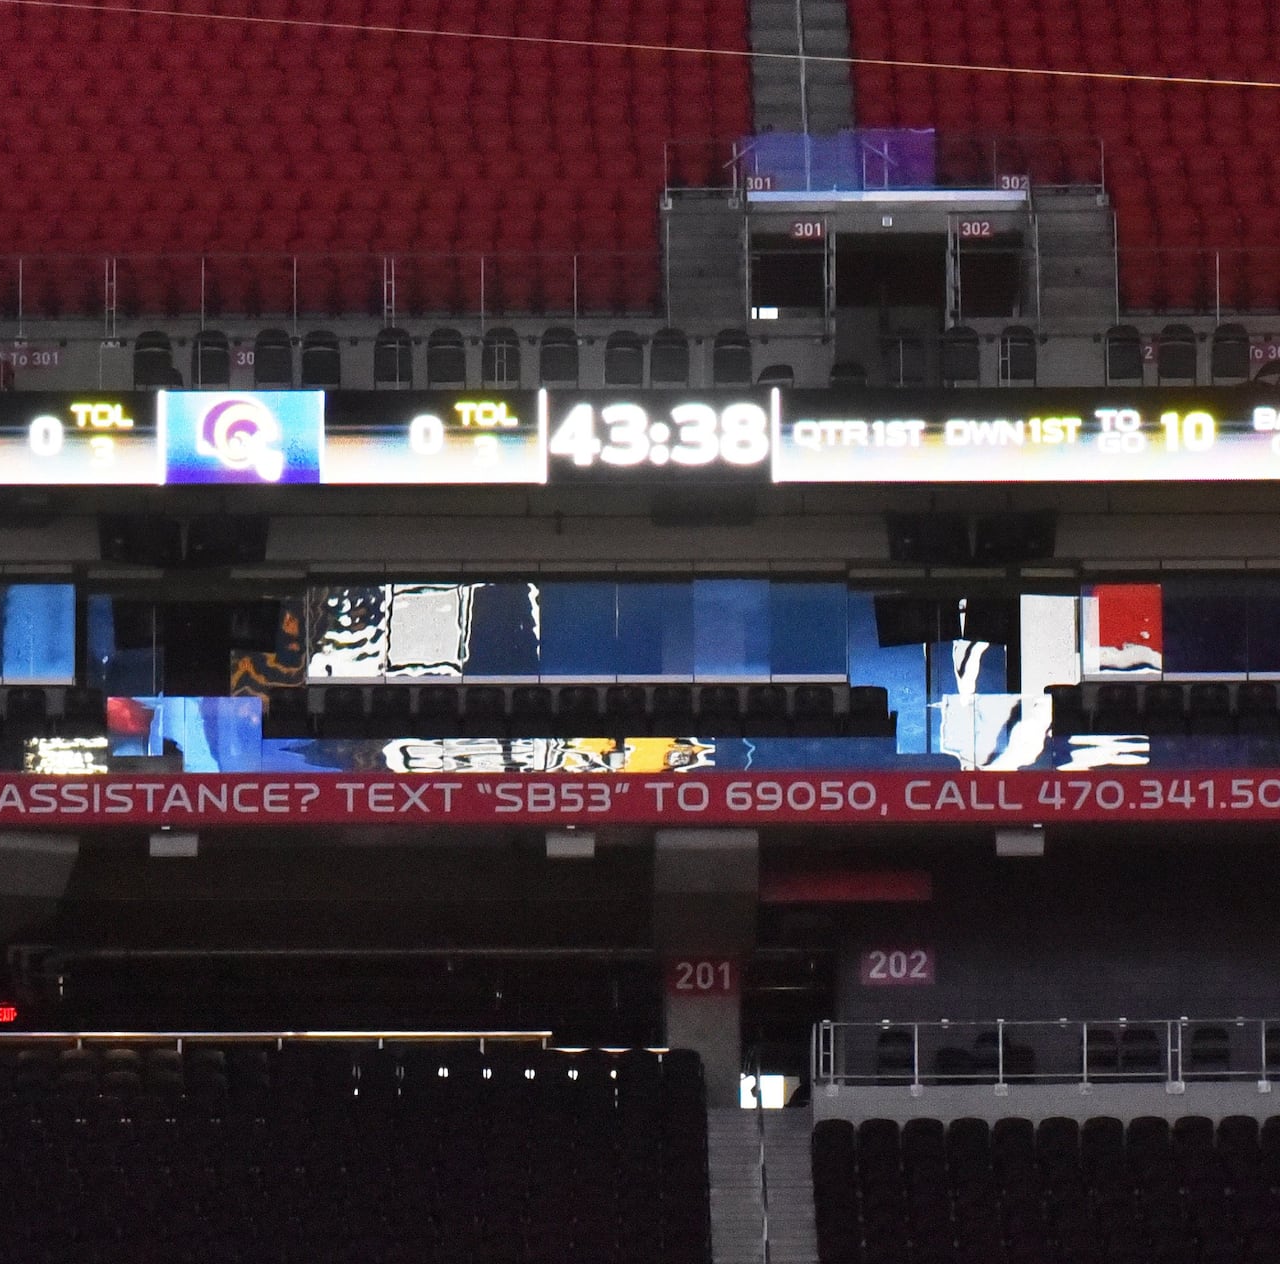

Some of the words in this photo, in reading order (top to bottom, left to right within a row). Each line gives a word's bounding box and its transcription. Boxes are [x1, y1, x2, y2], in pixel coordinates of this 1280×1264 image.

[746, 177, 771, 190] 301
[1001, 176, 1029, 189] 302
[794, 223, 821, 236] 301
[962, 222, 990, 236] 302
[10, 352, 27, 366] To
[32, 351, 59, 365] 301
[70, 404, 133, 428] TOL
[454, 402, 518, 427] TOL
[1095, 409, 1141, 433] TO
[550, 402, 769, 466] 43:38
[793, 420, 868, 451] QTR
[871, 420, 926, 447] 1ST
[1029, 417, 1082, 444] 1ST
[1096, 431, 1146, 454] GO
[1160, 411, 1216, 453] 10
[335, 782, 463, 813] TEXT
[644, 781, 709, 812] TO
[726, 780, 888, 817] 69050,
[905, 780, 1023, 811] CALL
[675, 961, 731, 989] 201
[869, 950, 928, 979] 202
